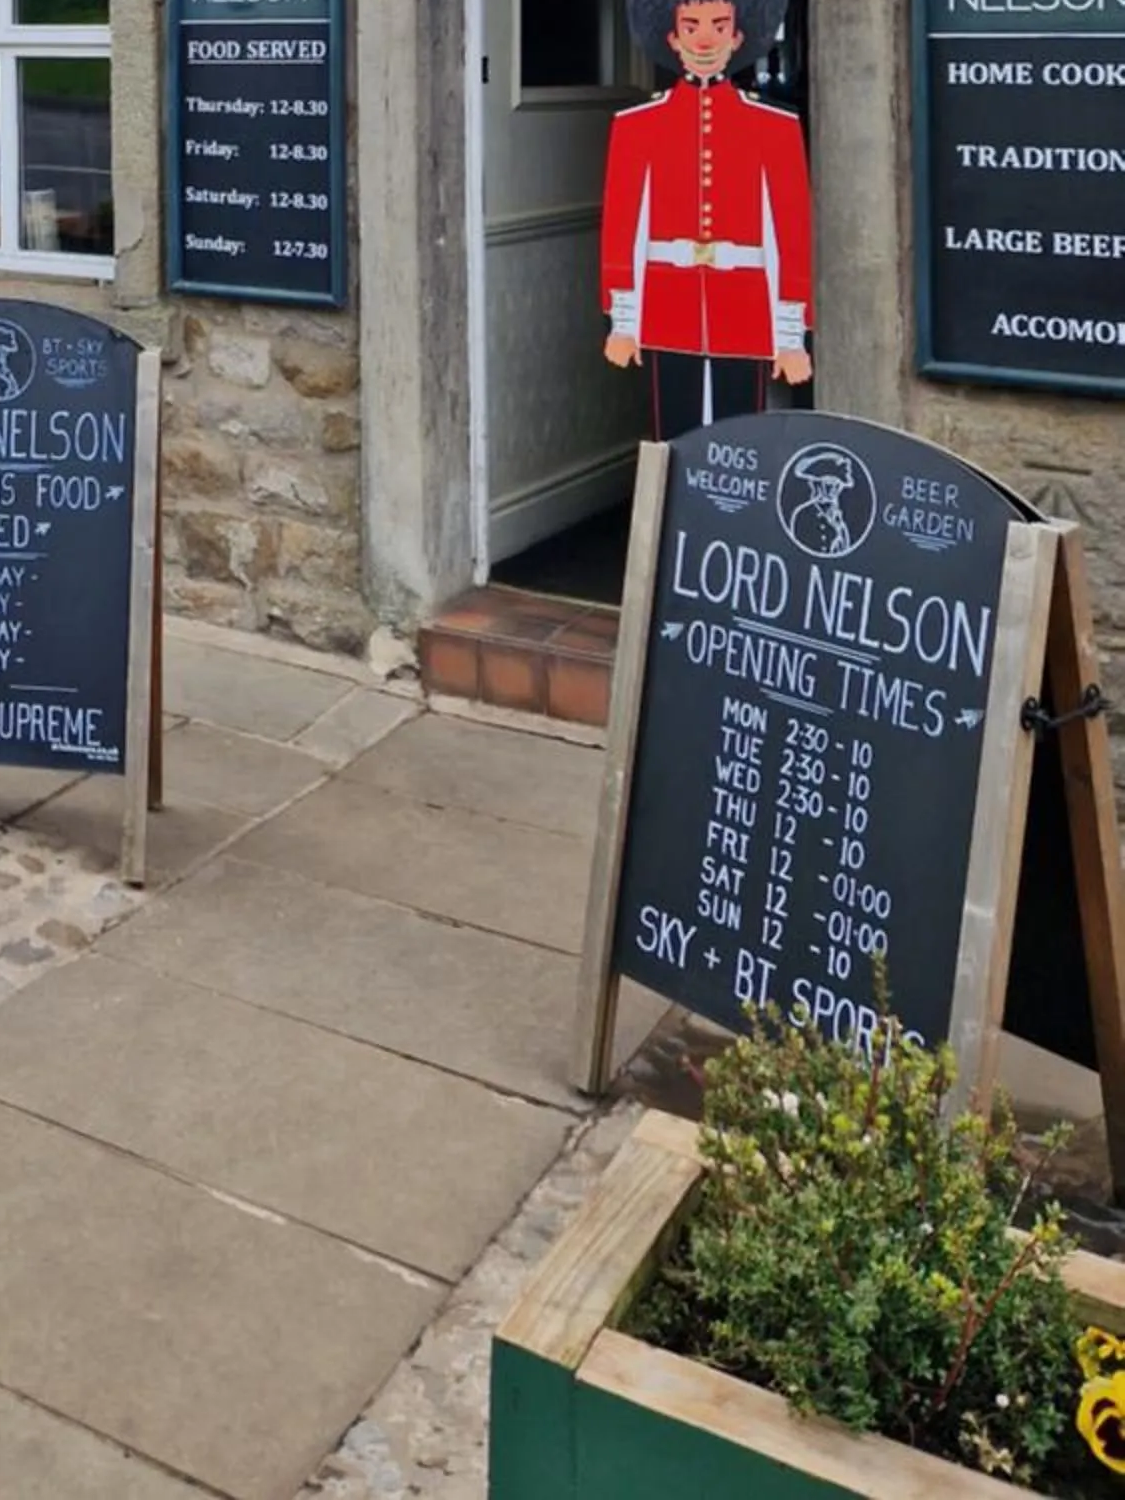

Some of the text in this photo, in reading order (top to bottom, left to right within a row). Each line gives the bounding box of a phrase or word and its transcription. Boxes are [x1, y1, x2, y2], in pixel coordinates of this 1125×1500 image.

[187, 39, 327, 60] FOOD SERVED
[947, 62, 1034, 85] HOME
[186, 96, 265, 117] Thursday:
[185, 139, 240, 160] Friday:
[185, 186, 260, 209] Saturday:
[185, 233, 246, 256] Sunday:
[945, 226, 1043, 254] LARGE
[707, 442, 759, 471] DOGS
[35, 473, 101, 511] FOOD
[686, 467, 770, 501] WELCOME
[901, 475, 960, 508] BEER
[882, 503, 975, 541] GARDEN
[673, 531, 991, 678] LORD NELSON
[686, 620, 947, 738] OPENING TIMES
[722, 696, 768, 734] MON
[851, 739, 873, 769] 10
[721, 725, 764, 766] TUE
[847, 771, 870, 801] 10
[716, 755, 761, 793] WED
[844, 803, 868, 833] 10
[712, 786, 757, 827] THU
[774, 812, 797, 845] 12
[839, 836, 865, 870] 10
[706, 820, 750, 864] FRI
[770, 846, 793, 882] 12
[700, 855, 746, 896] SAT
[765, 882, 789, 918] 12
[697, 889, 742, 931] SUN
[762, 916, 783, 950] 12
[827, 945, 852, 980] 10
[636, 905, 698, 968] SKY
[734, 948, 777, 1010] BT
